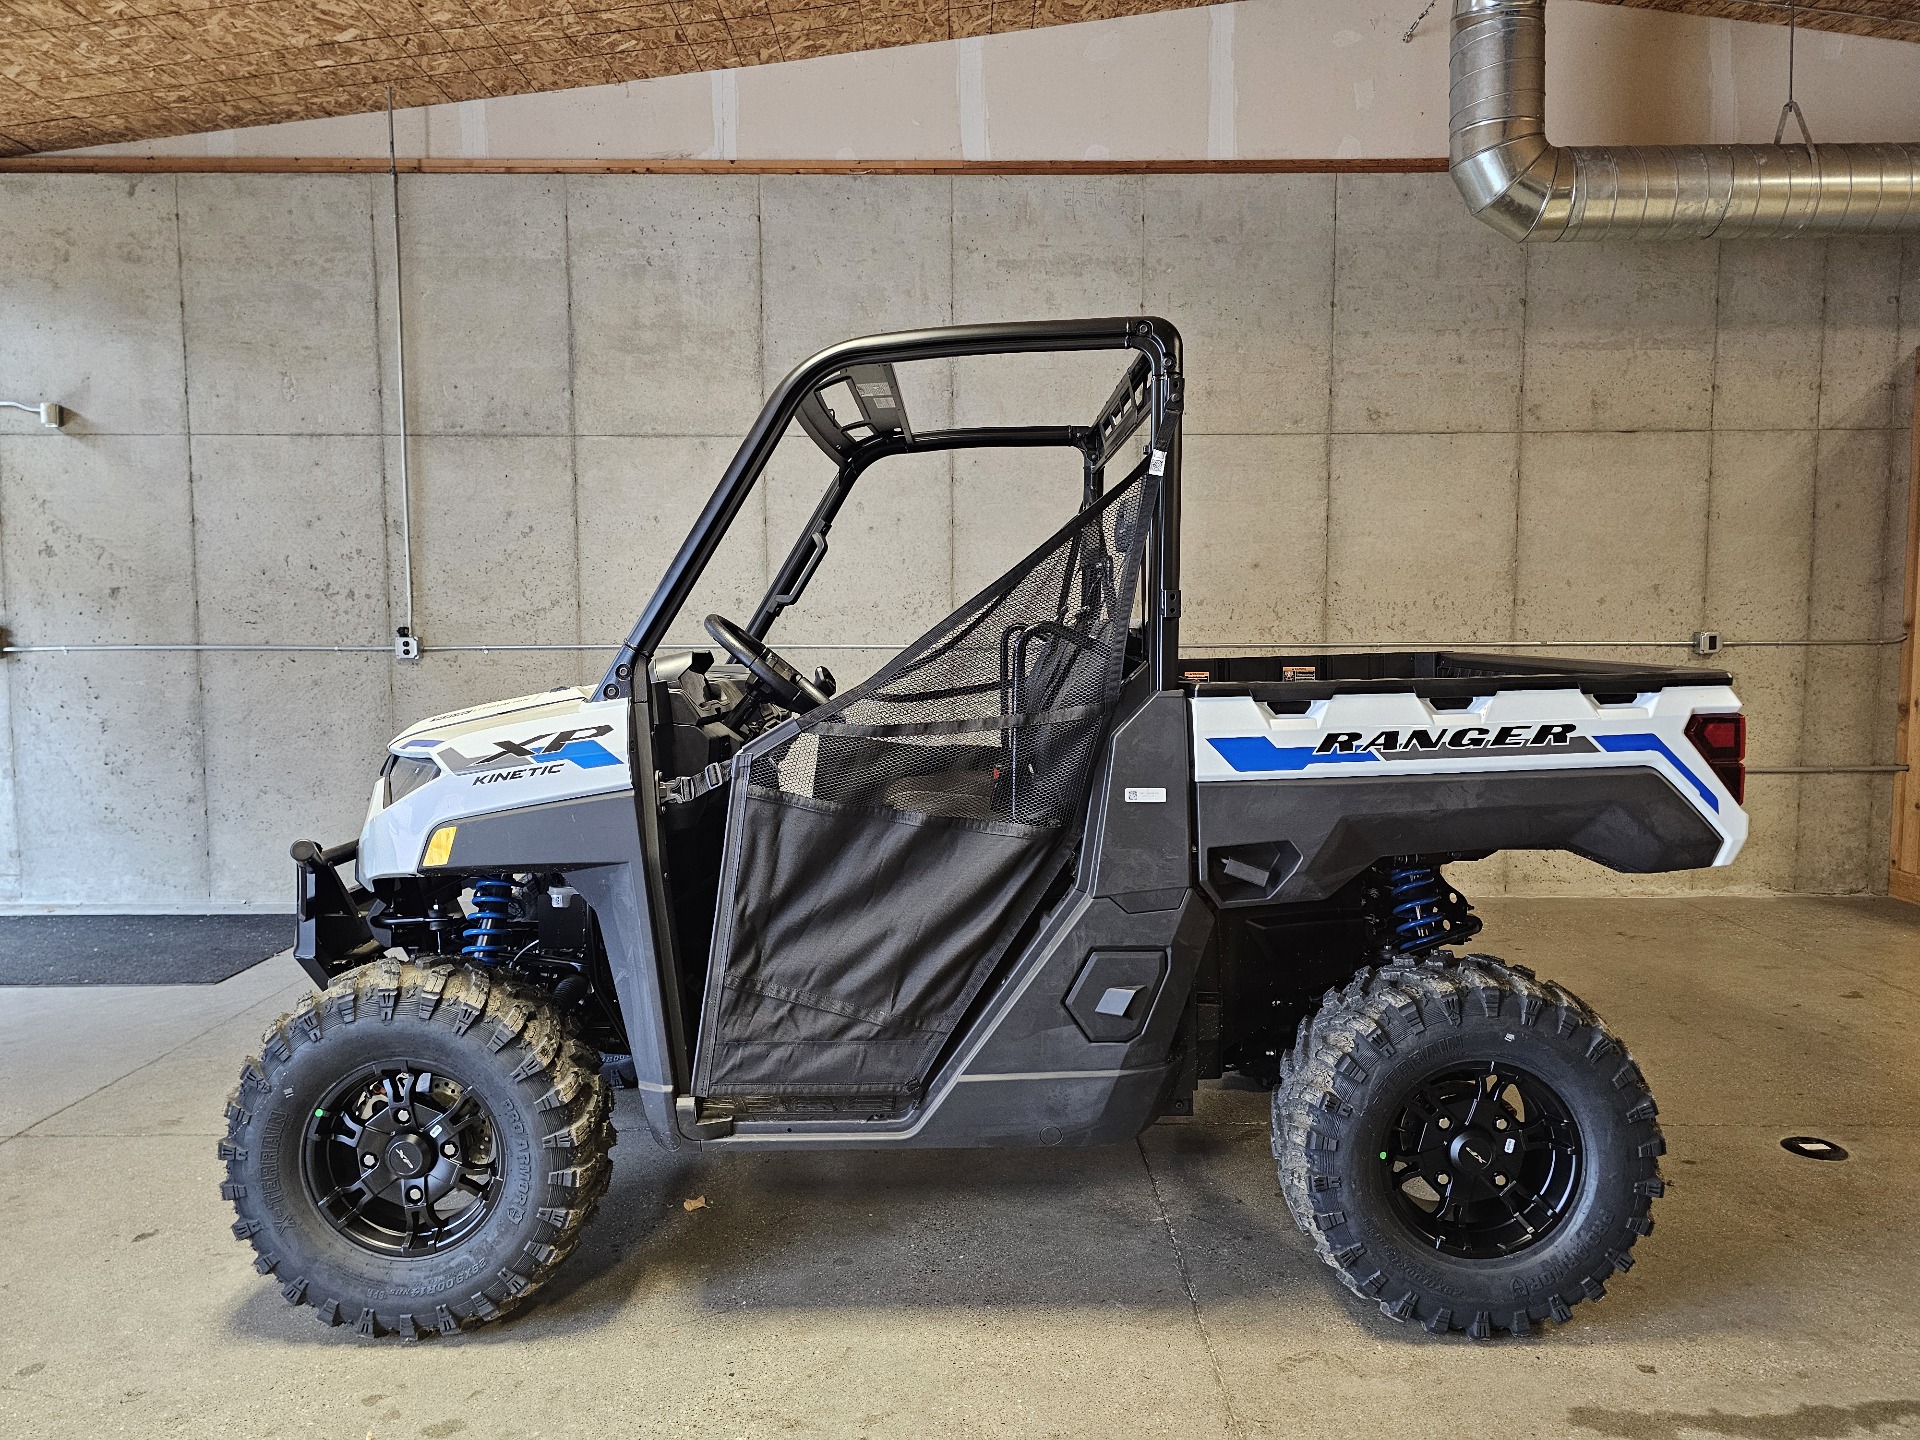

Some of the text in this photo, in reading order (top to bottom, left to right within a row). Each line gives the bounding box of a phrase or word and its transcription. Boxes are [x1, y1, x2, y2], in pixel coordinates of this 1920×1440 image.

[474, 725, 615, 765] XP
[1313, 723, 1578, 755] RANGER
[472, 763, 566, 787] KINETIC
[259, 1109, 296, 1236] X-TERRAIN
[517, 1139, 532, 1206] ARMOR
